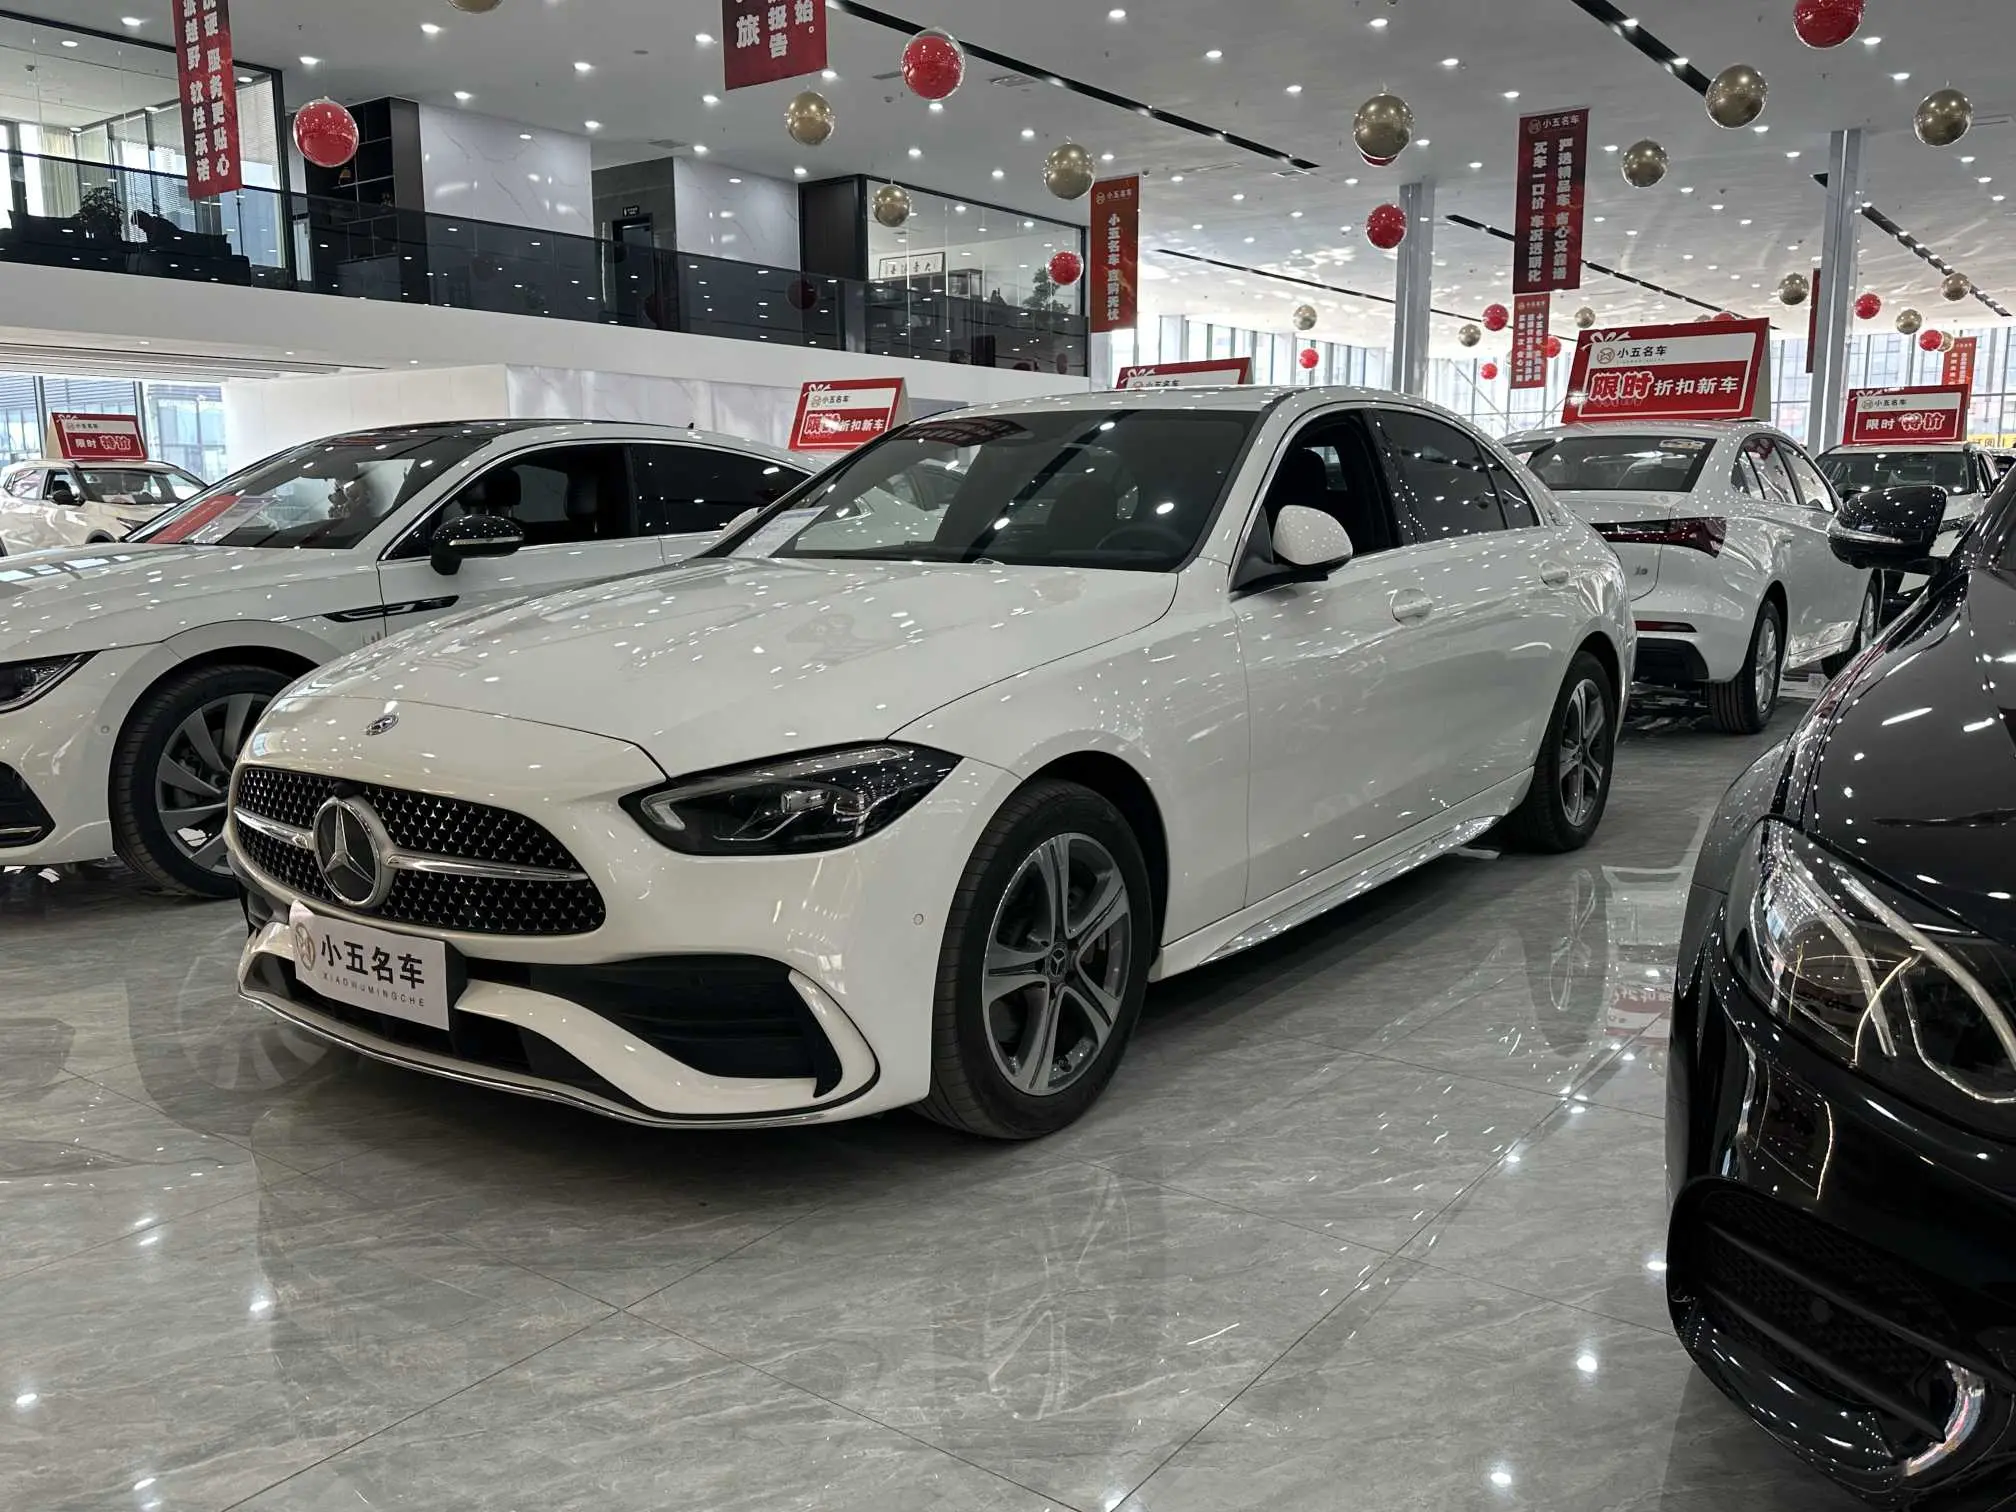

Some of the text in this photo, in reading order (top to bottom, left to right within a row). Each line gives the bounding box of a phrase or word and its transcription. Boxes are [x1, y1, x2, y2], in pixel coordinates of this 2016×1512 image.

[767, 0, 788, 58] 报告
[207, 48, 229, 177] 服务更贴心
[1543, 114, 1580, 129] 小五名车
[1528, 141, 1548, 282] 买车一口价 车况透明化
[1108, 213, 1120, 265] 小五名车
[1617, 345, 1668, 358] 小五名车
[321, 934, 425, 989] 小五名车
[322, 972, 425, 1007] XIAOWUMINGCHE
